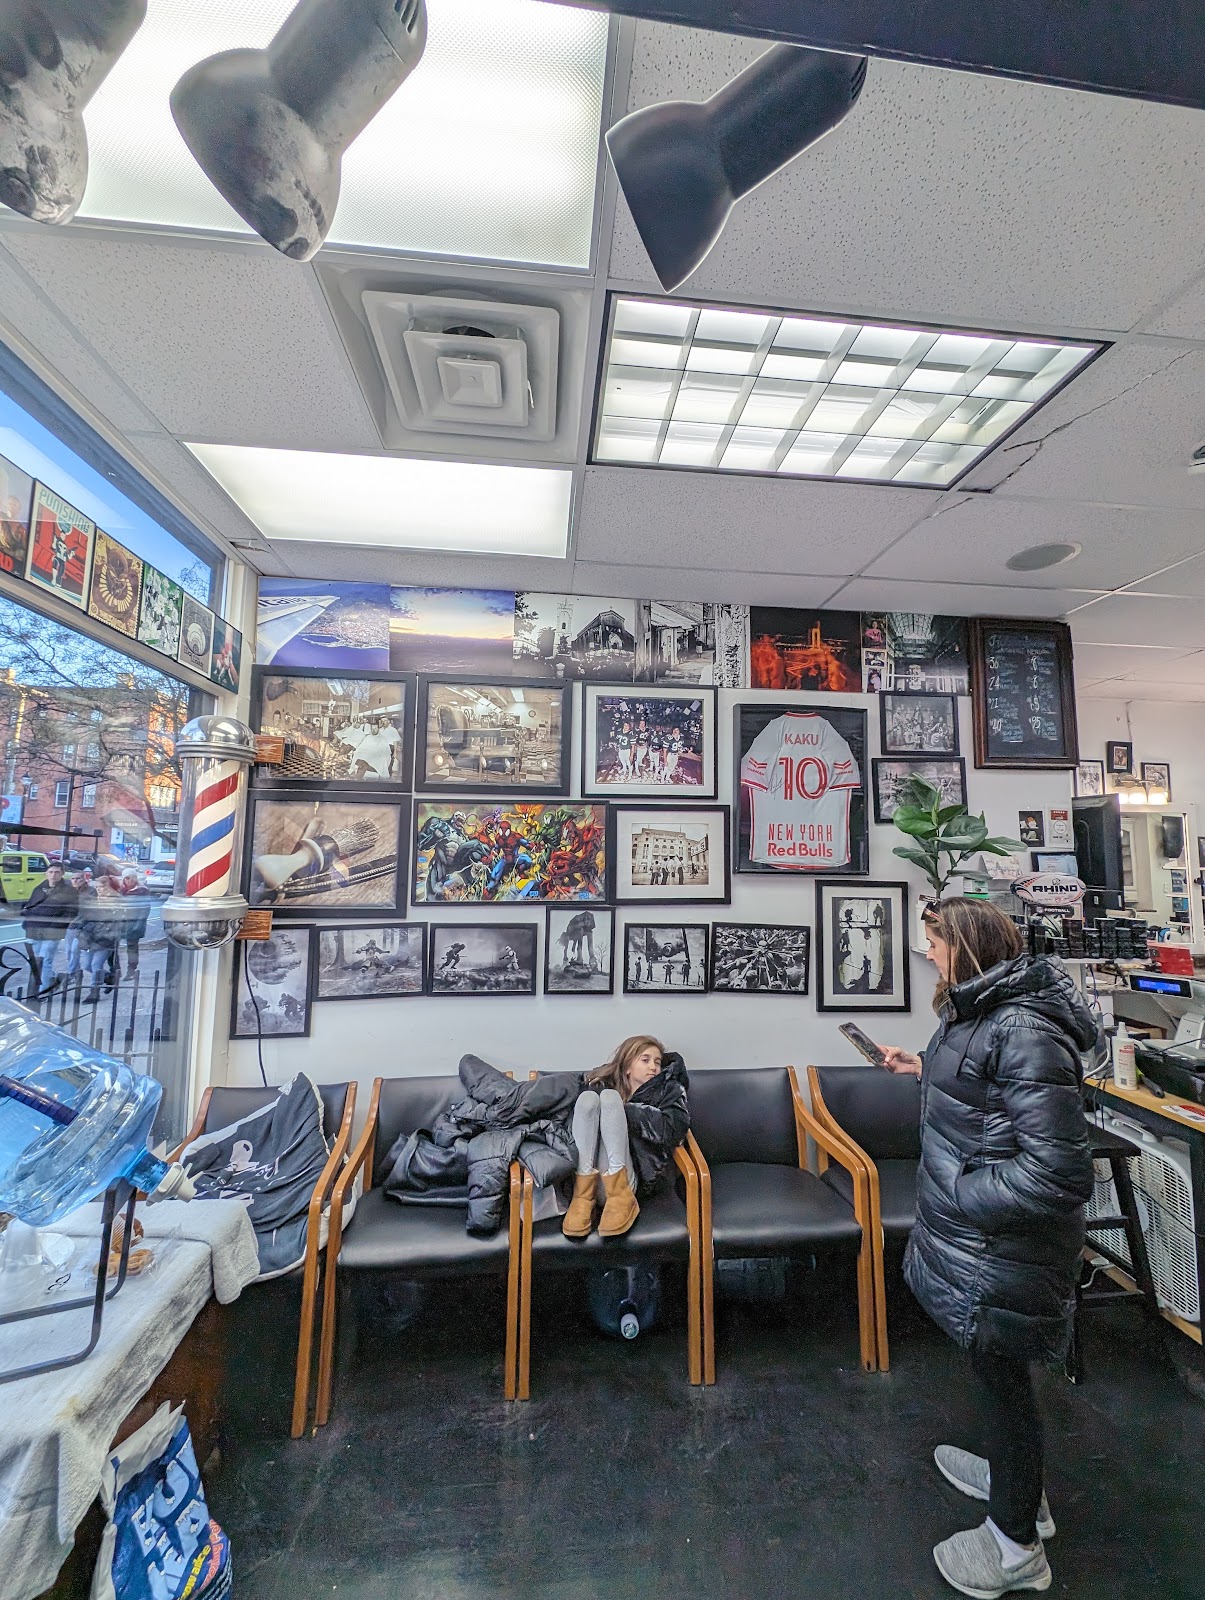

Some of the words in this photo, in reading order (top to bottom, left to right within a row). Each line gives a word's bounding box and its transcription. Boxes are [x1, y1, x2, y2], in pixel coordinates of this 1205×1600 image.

[39, 487, 91, 533] PUNISHING
[784, 733, 819, 747] KAKU
[778, 756, 828, 801] 10
[768, 823, 793, 841] NEW
[799, 824, 833, 842] YORK
[767, 842, 796, 857] Red
[798, 842, 833, 858] Bulls
[1032, 884, 1078, 893] RHINO
